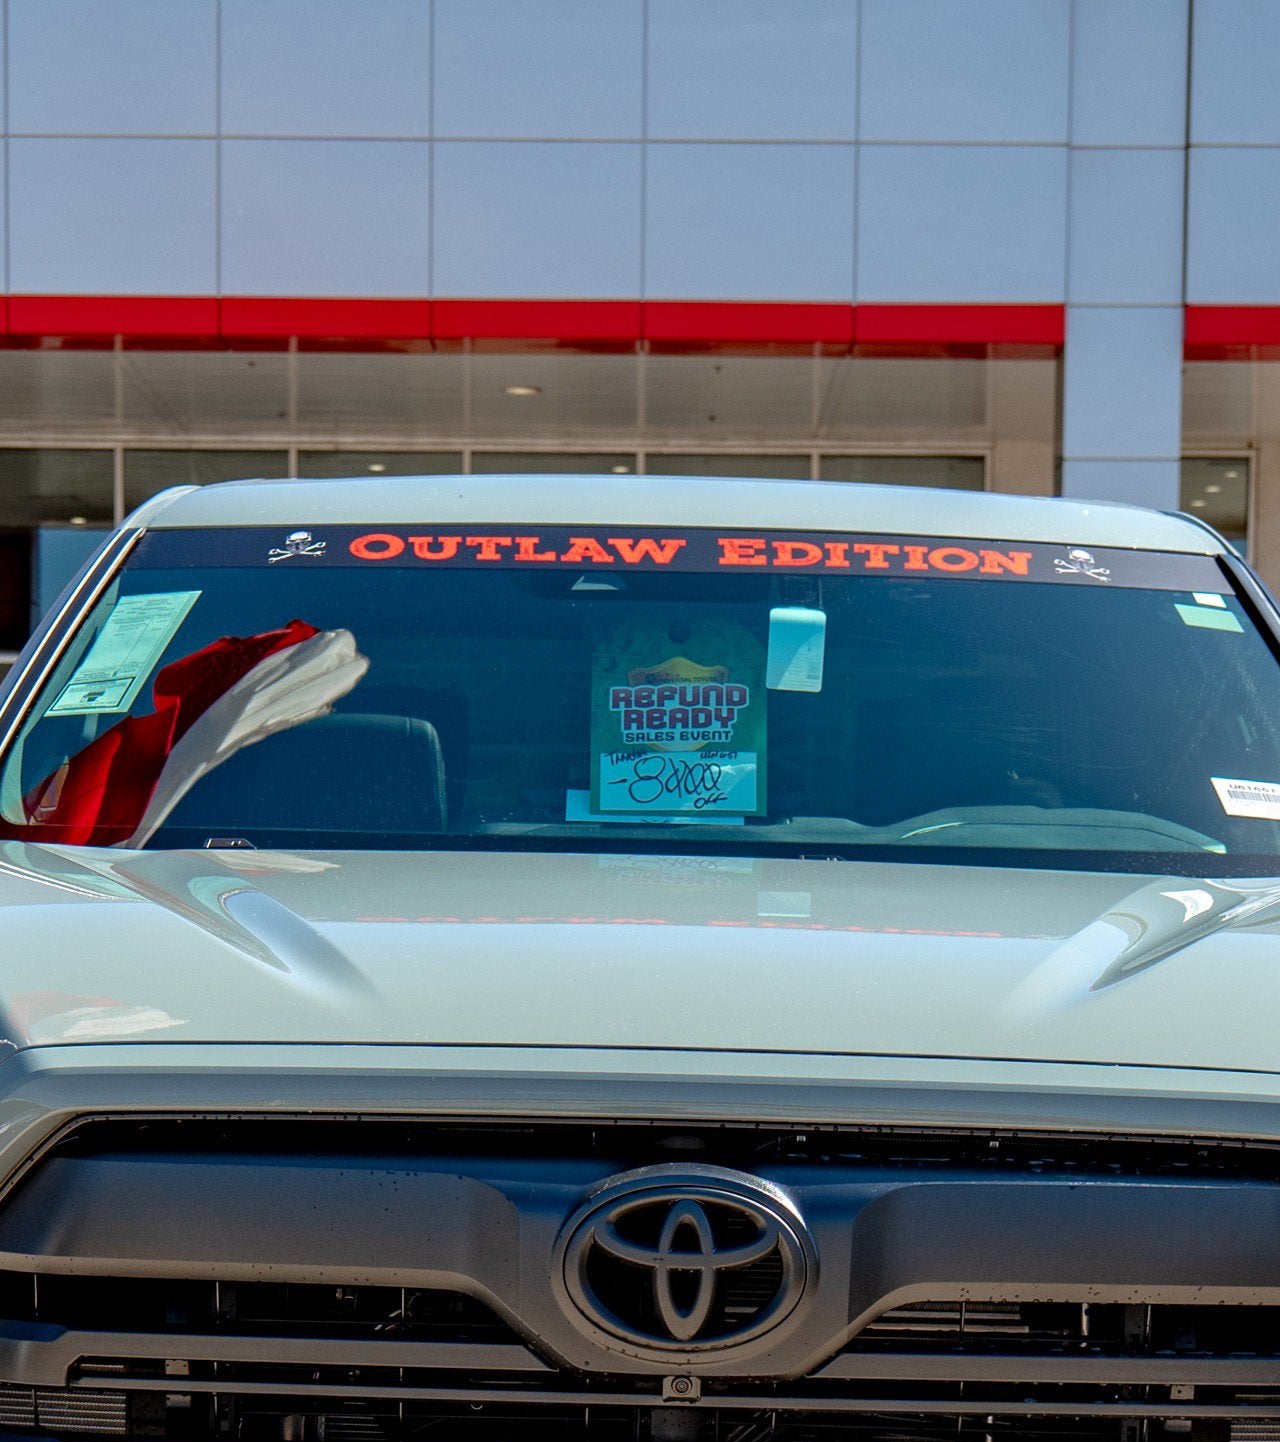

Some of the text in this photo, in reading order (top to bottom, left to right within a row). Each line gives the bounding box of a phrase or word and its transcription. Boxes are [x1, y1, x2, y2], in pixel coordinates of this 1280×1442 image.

[349, 533, 1033, 575] OUTLAW EDITION
[611, 685, 748, 709] REFUND
[623, 707, 736, 731] READY
[624, 730, 732, 743] SALES EVENT
